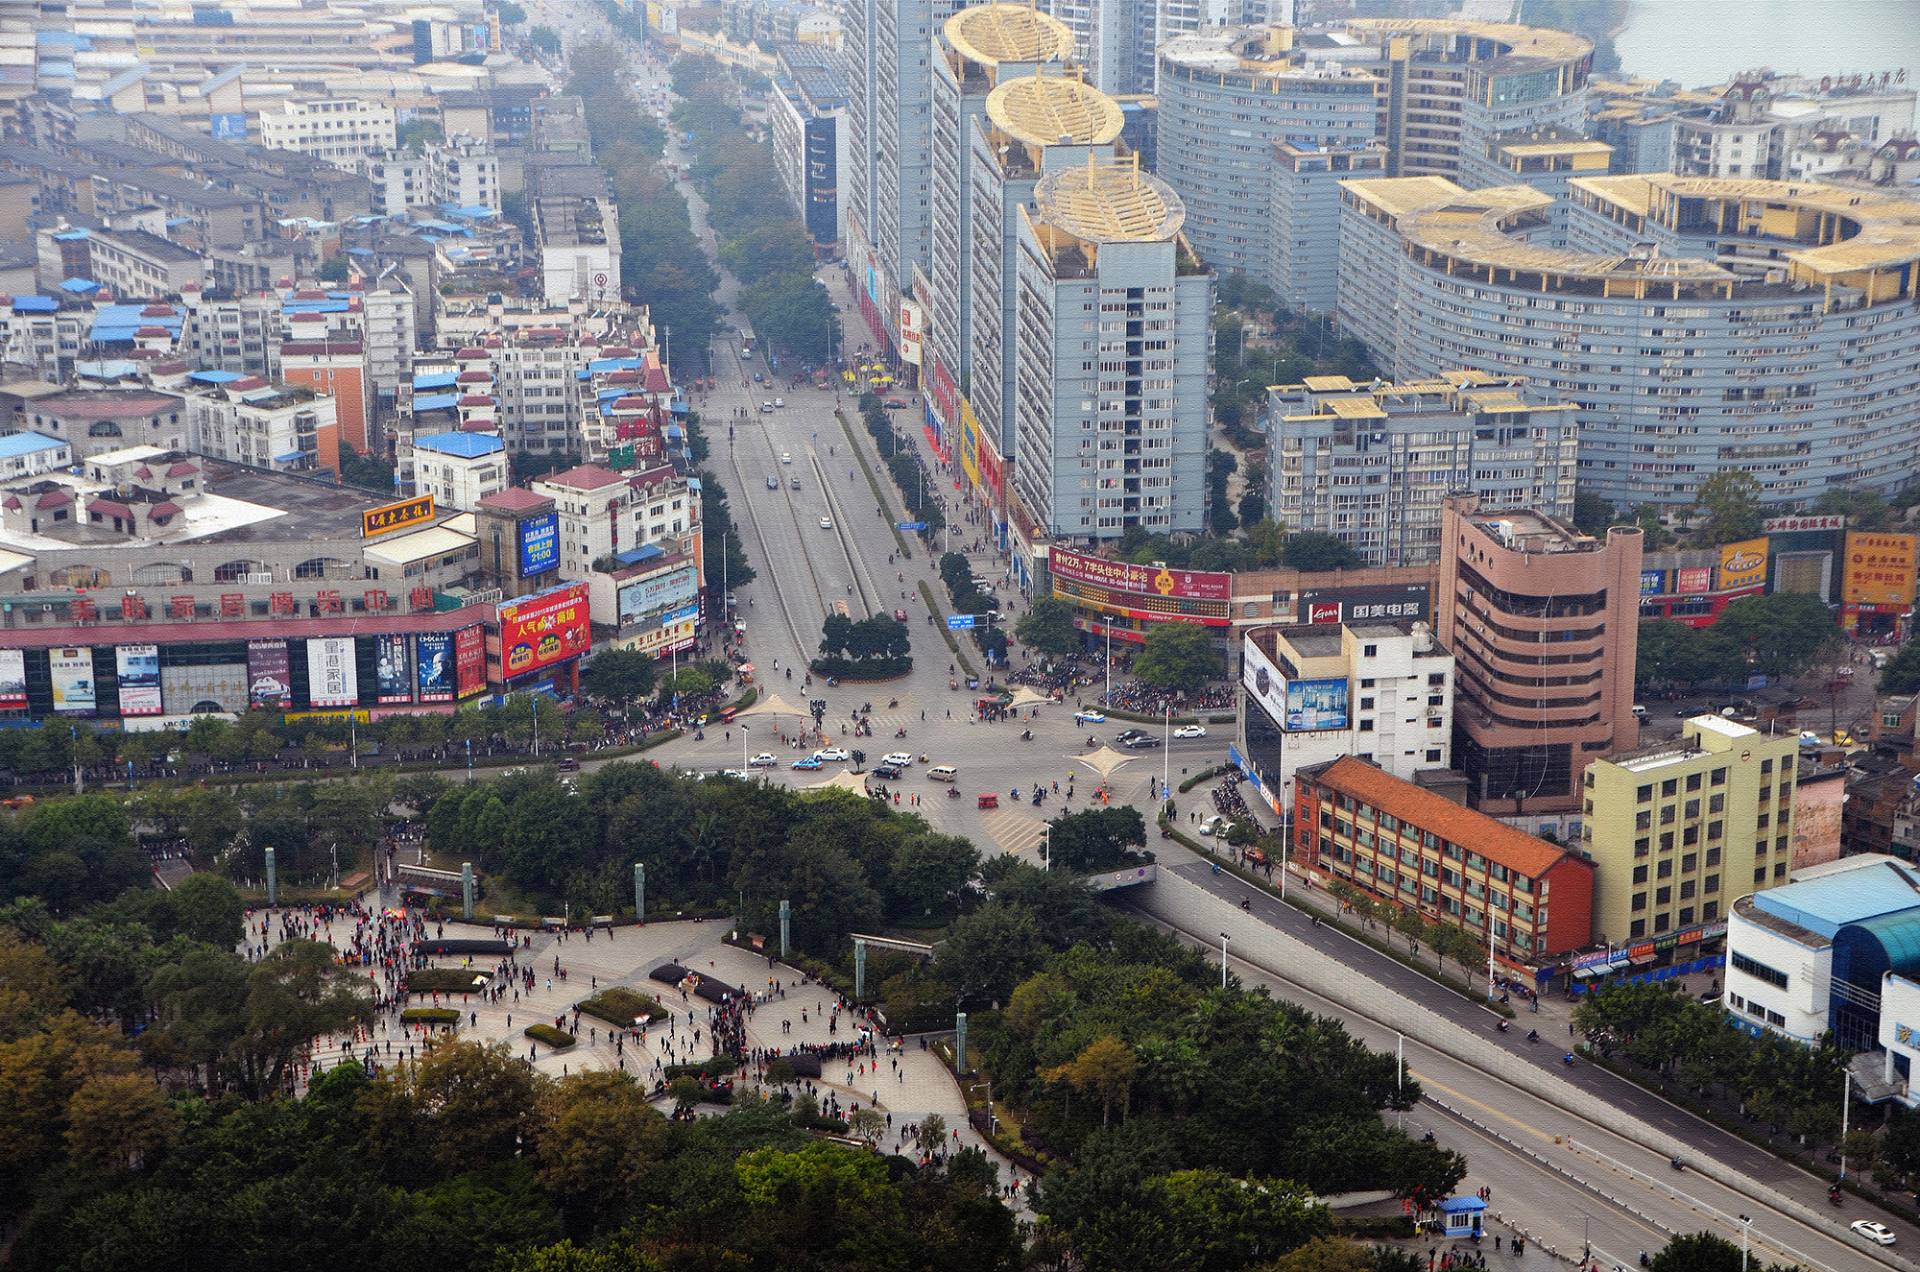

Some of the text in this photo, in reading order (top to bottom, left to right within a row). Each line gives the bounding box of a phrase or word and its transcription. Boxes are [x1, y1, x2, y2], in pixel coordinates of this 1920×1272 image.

[531, 550, 551, 562] 21:00
[1353, 603, 1419, 618] 国美电器
